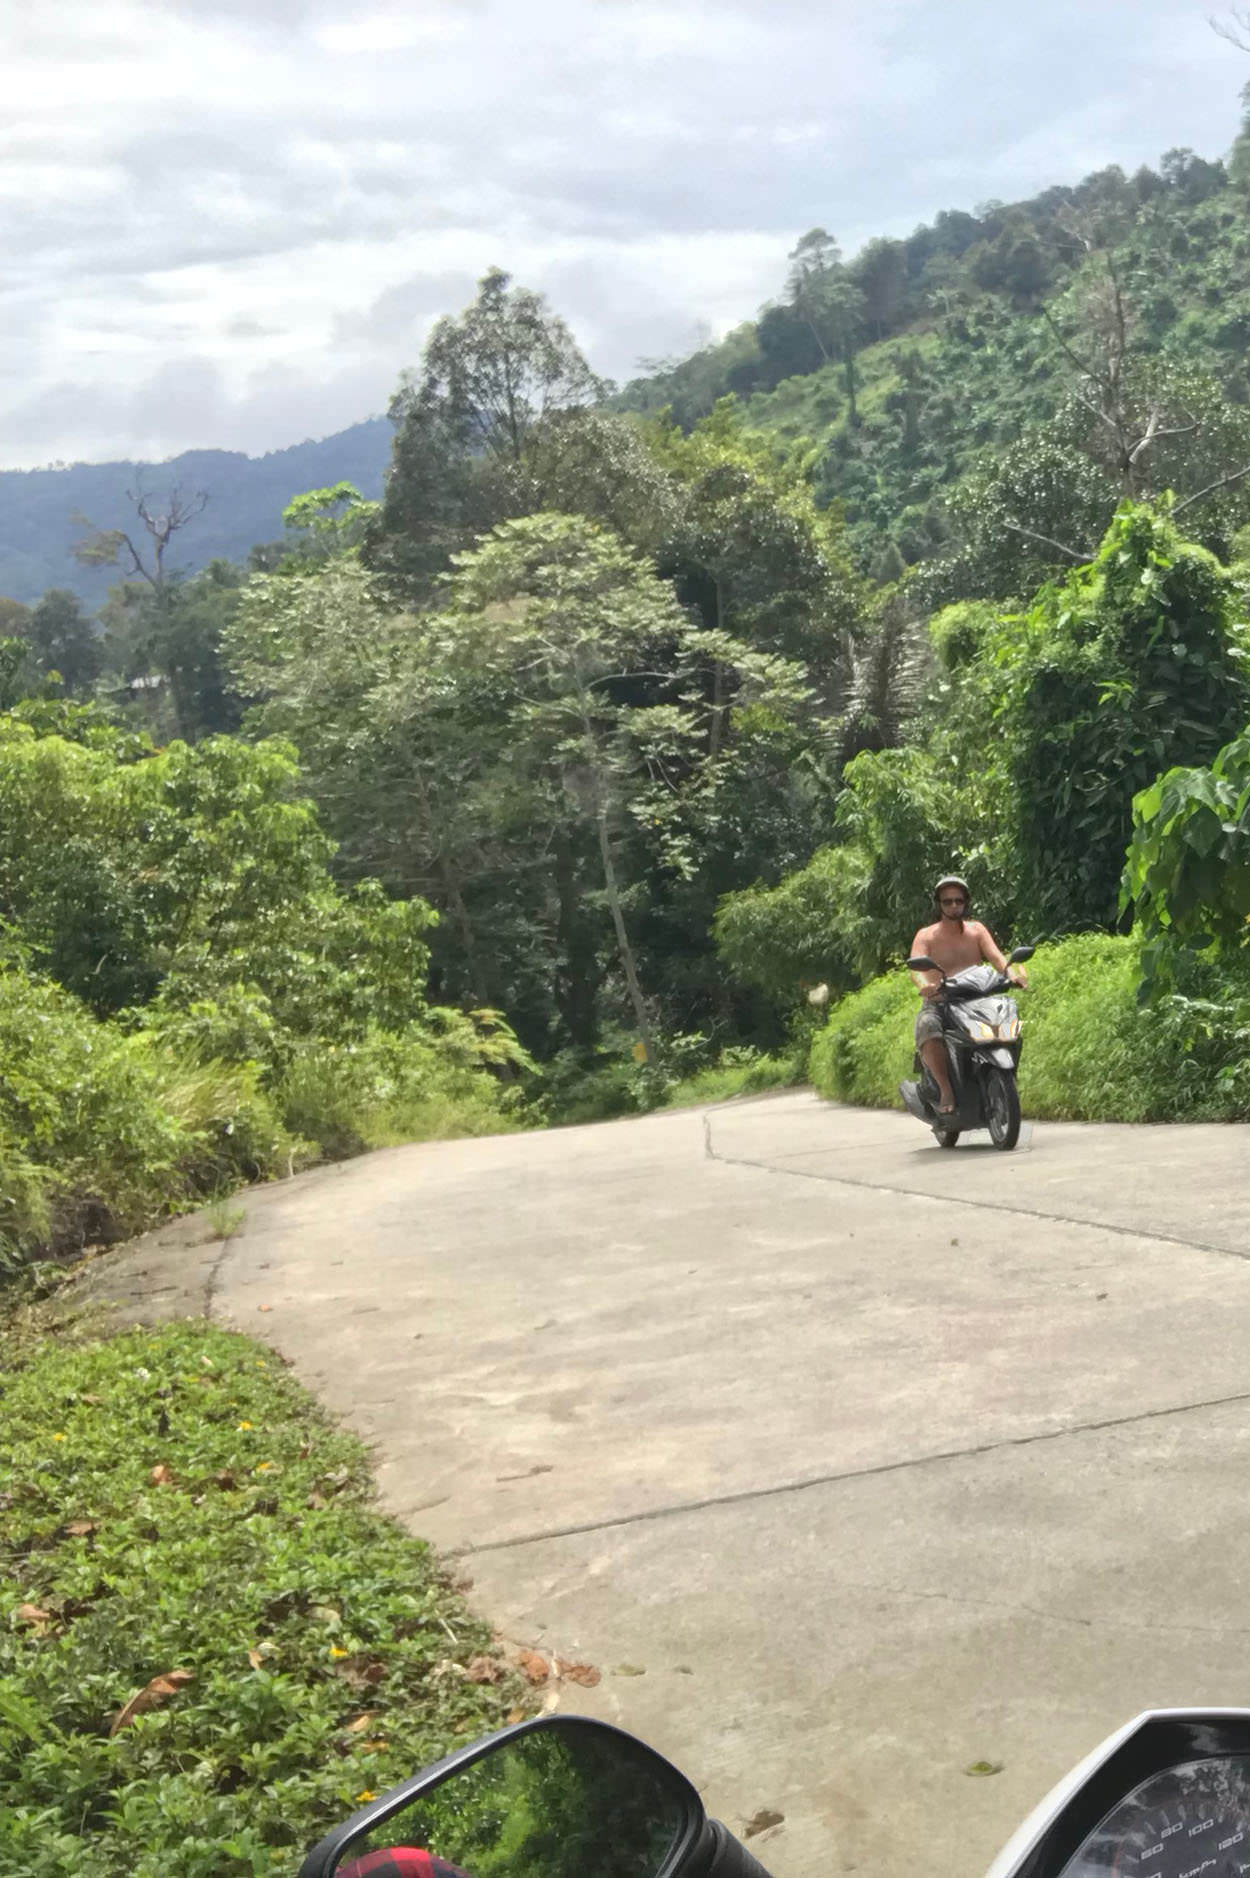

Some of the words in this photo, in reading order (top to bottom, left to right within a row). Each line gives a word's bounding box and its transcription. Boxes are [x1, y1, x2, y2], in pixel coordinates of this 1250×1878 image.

[1161, 1822, 1184, 1839] 80
[1188, 1819, 1214, 1838] 100
[1218, 1832, 1244, 1851] 120
[1141, 1843, 1164, 1860] 60
